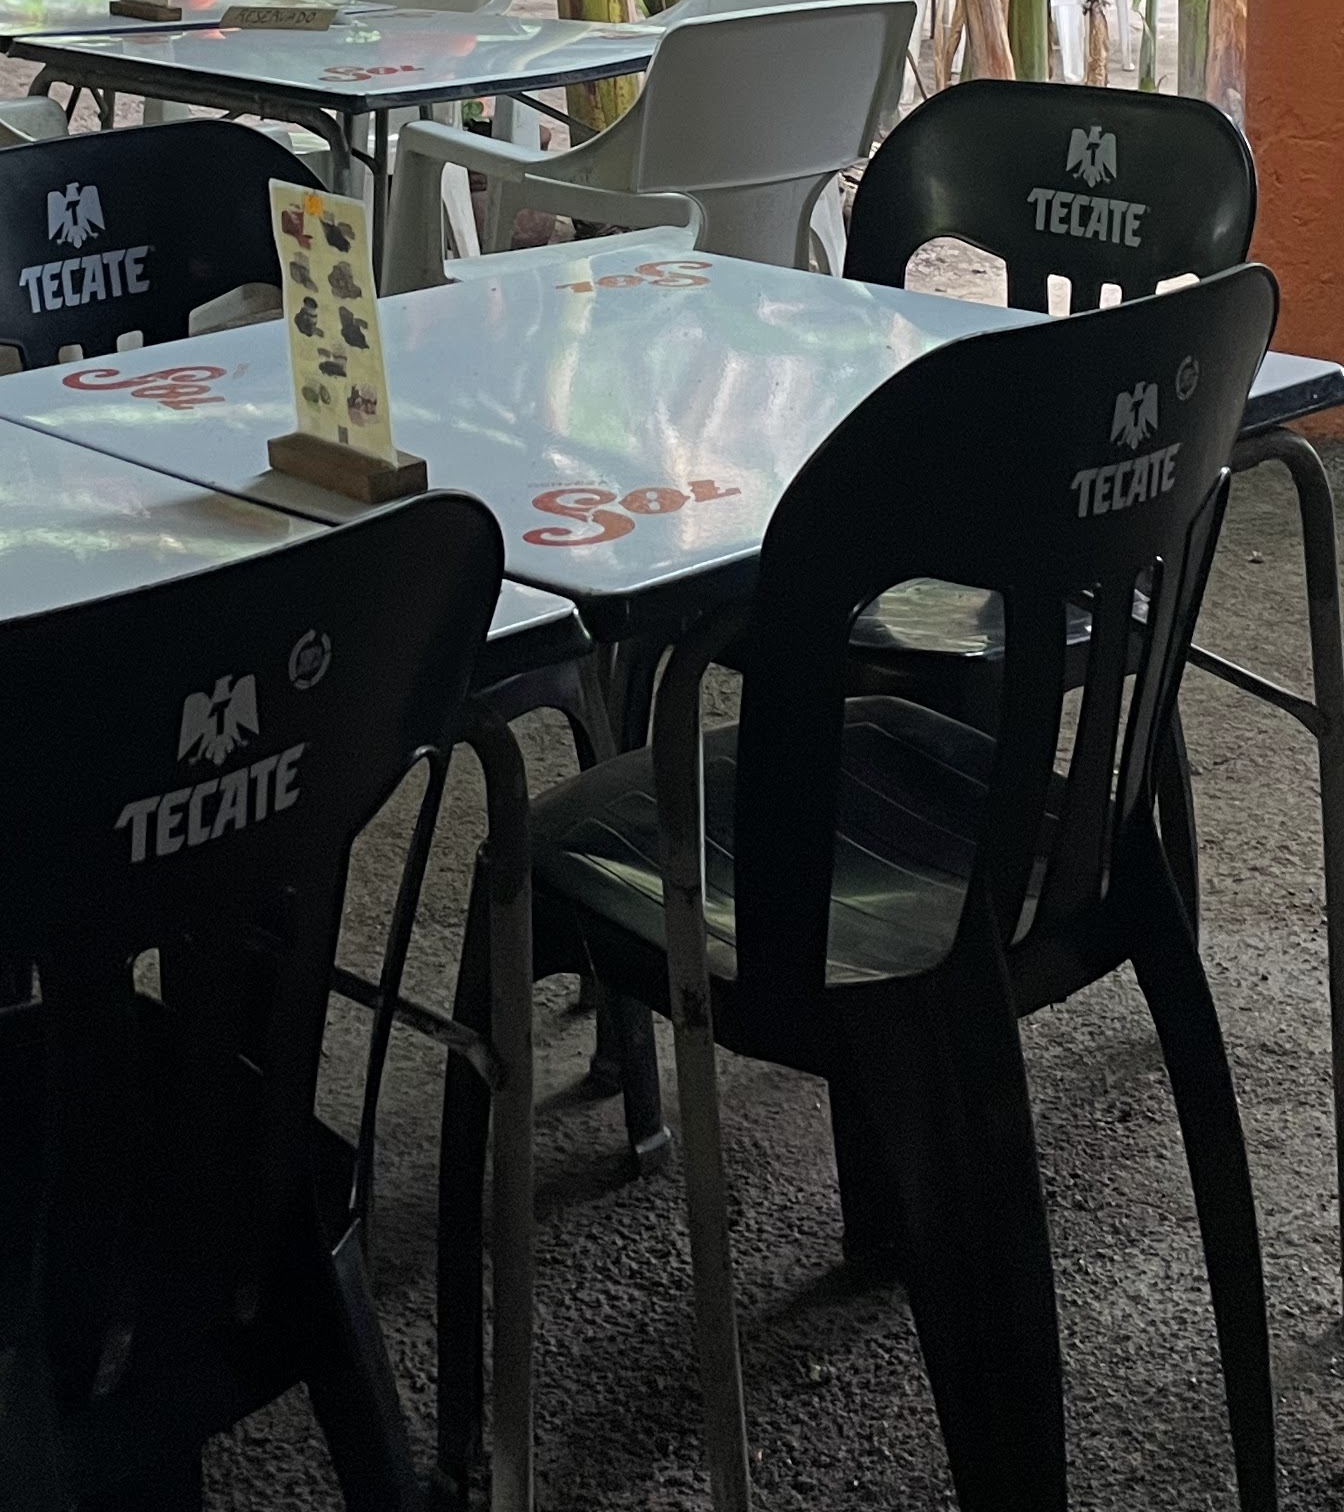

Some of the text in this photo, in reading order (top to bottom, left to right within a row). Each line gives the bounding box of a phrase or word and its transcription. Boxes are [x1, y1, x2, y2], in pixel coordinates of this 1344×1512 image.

[1027, 187, 1148, 248] TECATE
[19, 245, 152, 314] TECATE
[1071, 442, 1181, 518] TECATE
[113, 741, 307, 864] TECATE
